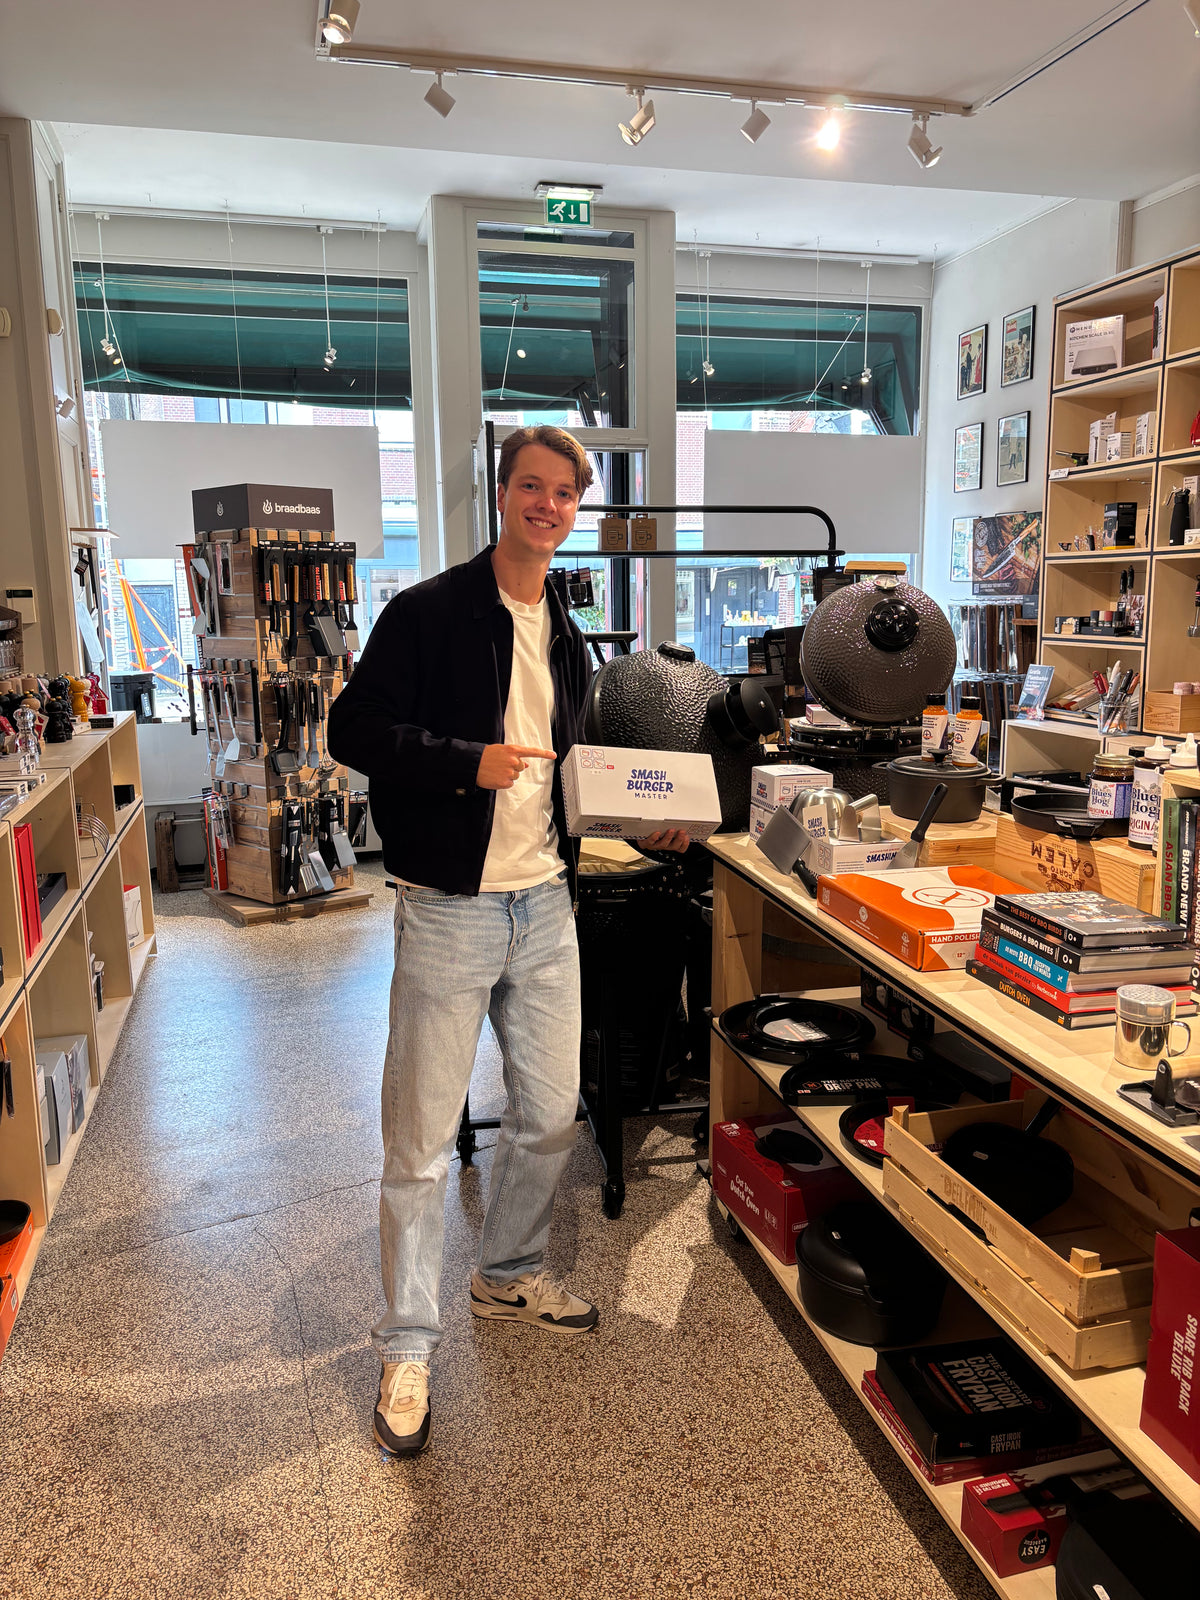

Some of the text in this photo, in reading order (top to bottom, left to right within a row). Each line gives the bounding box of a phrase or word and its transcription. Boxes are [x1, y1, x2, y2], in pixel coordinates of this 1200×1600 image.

[274, 502, 320, 514] braadbaas
[630, 768, 667, 781] SMASH
[626, 780, 674, 793] BURGER
[1092, 788, 1112, 798] Blues
[1092, 796, 1110, 808] Hog
[1132, 800, 1157, 818] Hog
[808, 816, 822, 829] SMASH
[1050, 866, 1073, 880] PORTO
[1164, 841, 1174, 884] ASIAN
[1178, 848, 1190, 921] BRAND NEW
[1162, 884, 1173, 912] BBQ
[1010, 906, 1062, 936] THE BEST OF BBQ BIRDS
[932, 935, 952, 943] HAND
[1000, 922, 1054, 956] BURGERS & BBQ BITES
[1018, 951, 1033, 969] BBQ
[999, 981, 1031, 1006] DUTCH OVEN
[1005, 966, 1014, 975] van
[1036, 984, 1058, 1000] barbecook
[823, 1080, 882, 1091] DRIP PAN
[735, 1174, 754, 1198] Cast Iron
[730, 1180, 760, 1216] Dutch Oven
[1170, 1330, 1184, 1382] DELUXE
[1178, 1314, 1198, 1416] SPARE RIB RACK
[942, 1360, 1005, 1413] FRYPAN
[966, 1356, 1024, 1408] CAST IRON
[985, 1352, 1033, 1405] THE BASTARD
[990, 1432, 1021, 1443] CAST IRON
[991, 1440, 1022, 1454] FRYPAN
[1022, 1544, 1045, 1557] EASY
